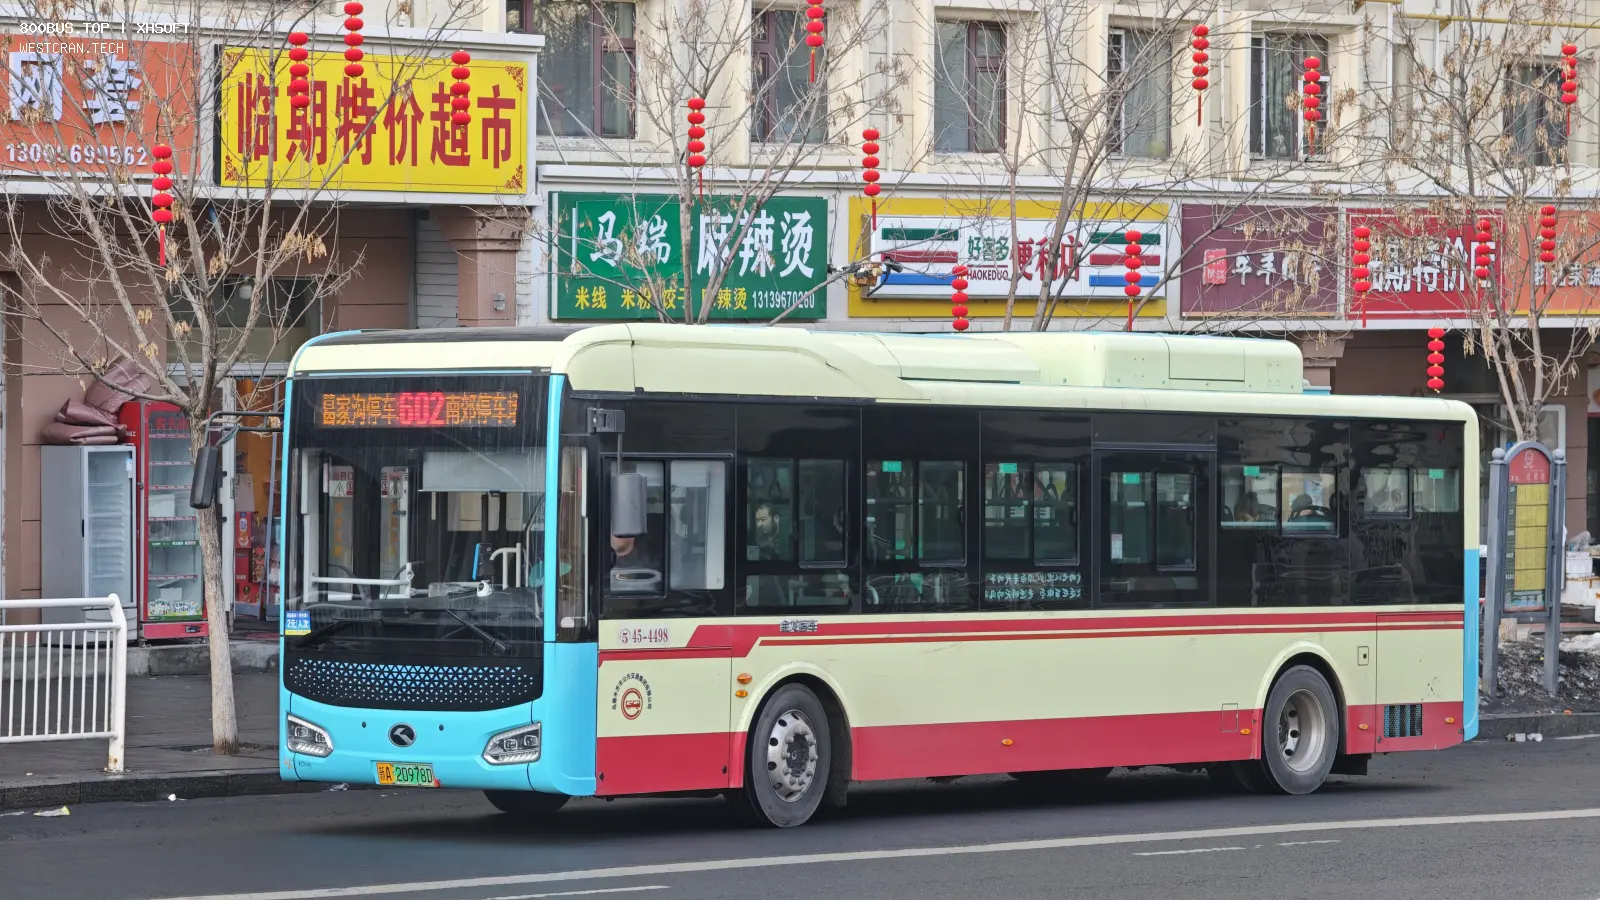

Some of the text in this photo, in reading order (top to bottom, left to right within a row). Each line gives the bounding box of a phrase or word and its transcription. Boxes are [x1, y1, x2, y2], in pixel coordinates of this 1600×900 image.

[237, 70, 516, 169] 临期特价超市
[696, 209, 815, 279] 麻辣烫
[1010, 234, 1083, 282] 便利店
[967, 269, 1009, 281] HAOKEDUO
[574, 285, 607, 310] 米线
[398, 392, 446, 427] 602
[632, 627, 668, 643] 45-4498
